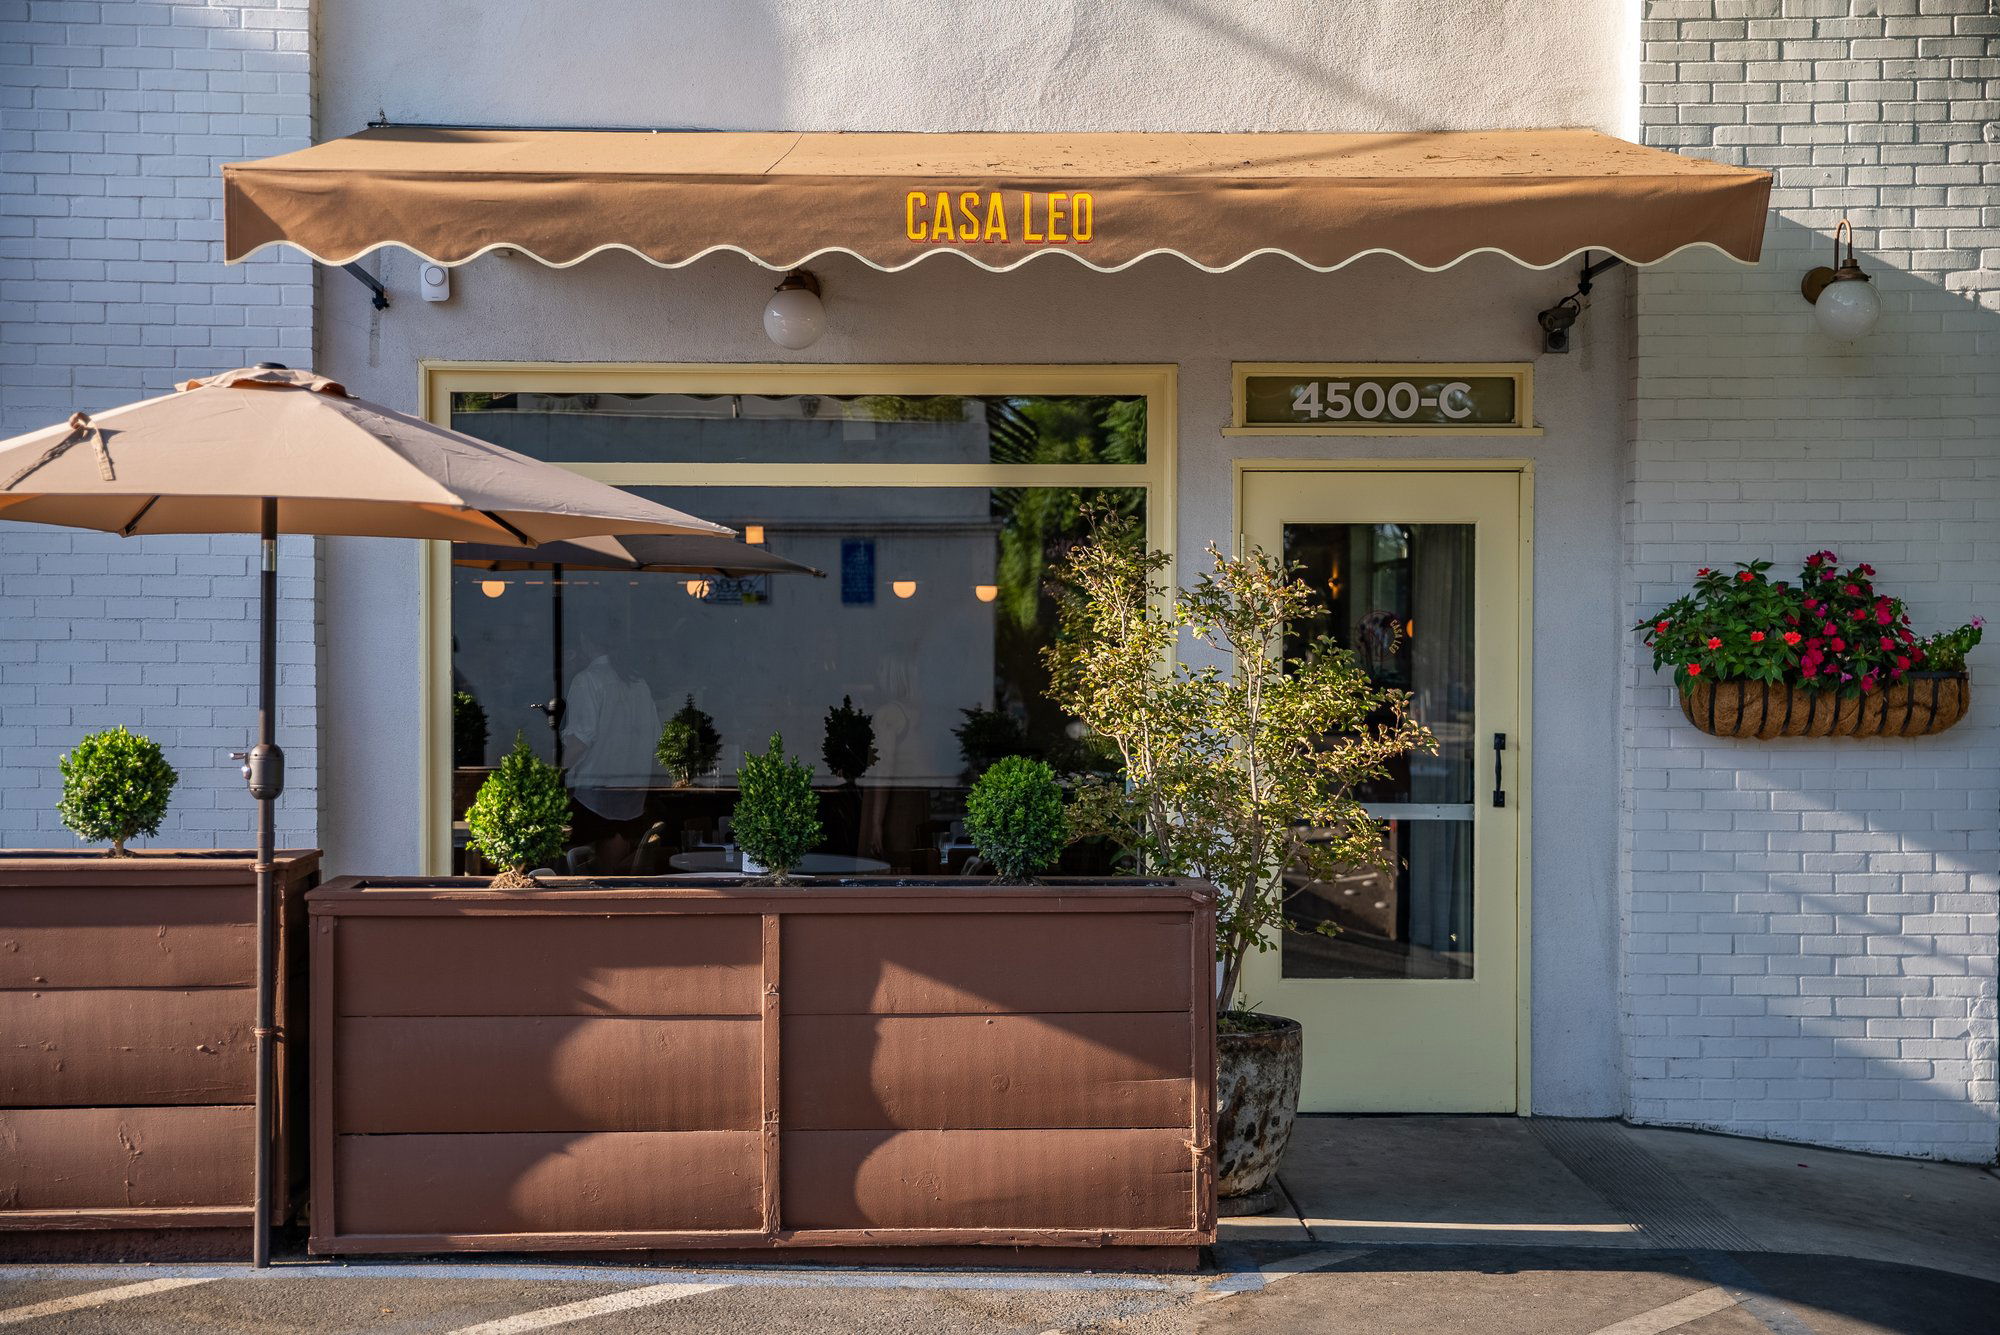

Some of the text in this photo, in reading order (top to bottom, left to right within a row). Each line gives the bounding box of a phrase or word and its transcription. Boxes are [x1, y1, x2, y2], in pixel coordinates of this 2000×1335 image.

[906, 191, 1094, 244] CASA LEO
[1292, 381, 1472, 419] 4500-C
[1389, 619, 1403, 654] CASA LEO
